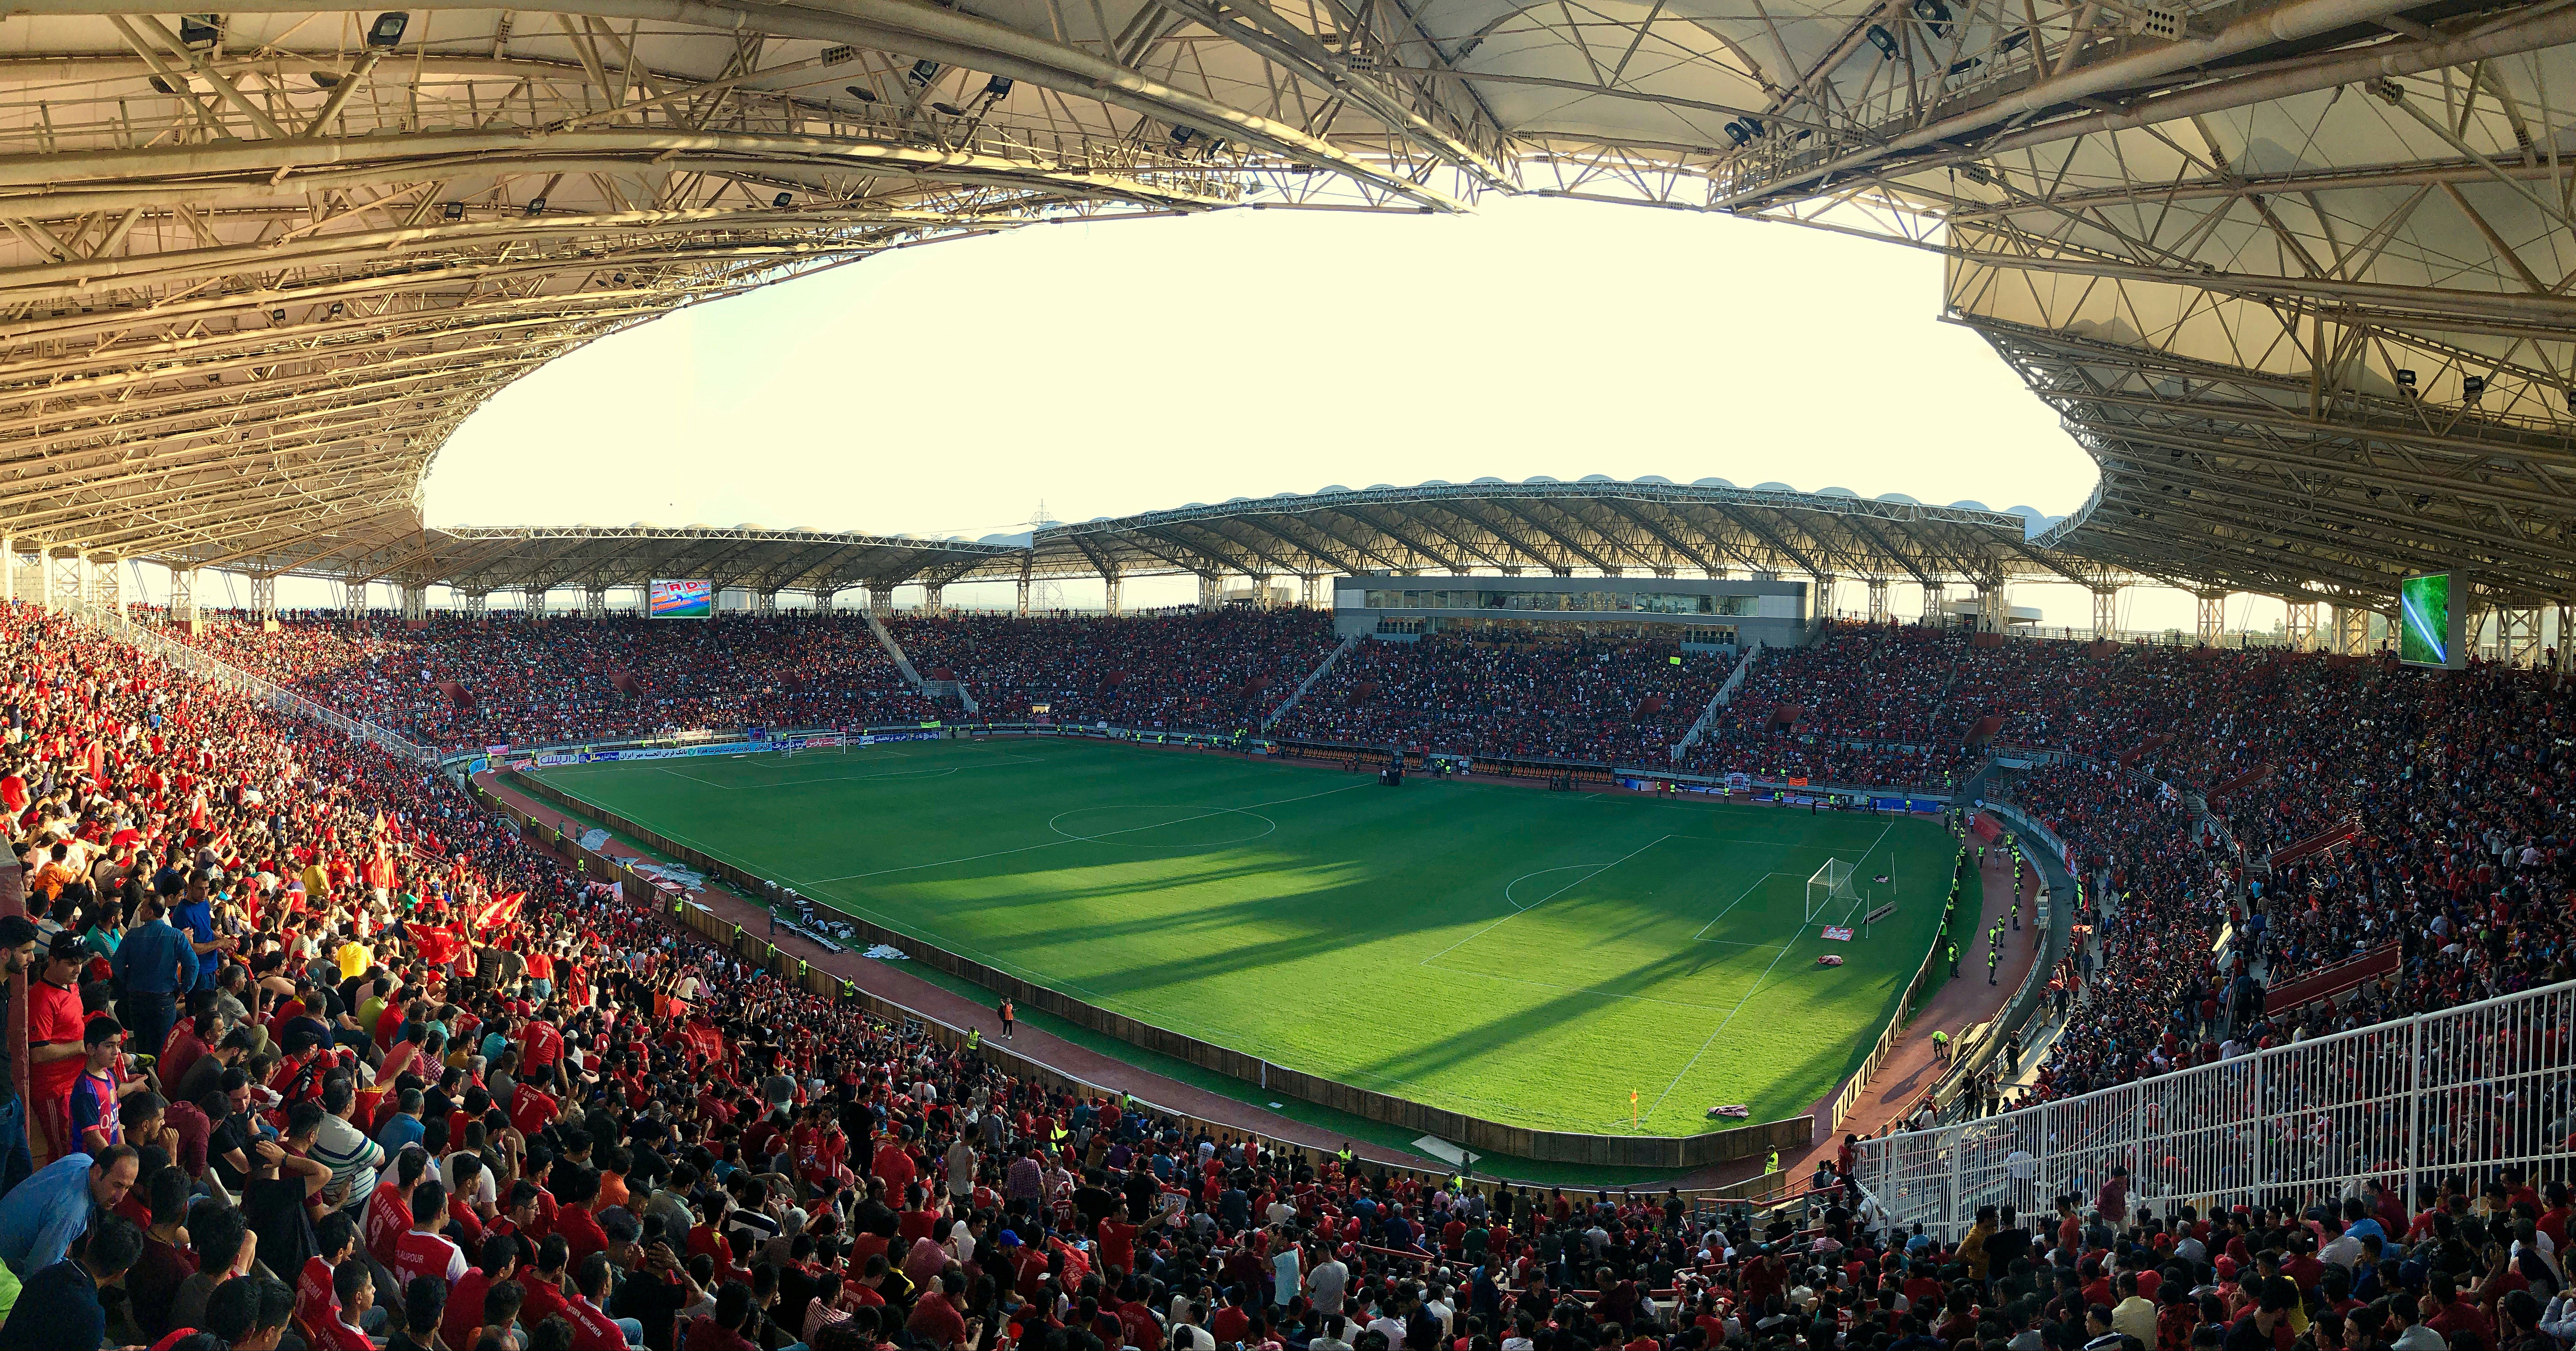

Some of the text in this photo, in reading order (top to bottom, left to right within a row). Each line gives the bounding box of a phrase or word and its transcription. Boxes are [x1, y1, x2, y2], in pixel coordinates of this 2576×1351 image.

[164, 1028, 180, 1053] 9
[538, 1031, 549, 1047] 7
[517, 1097, 528, 1116] 7
[1057, 1209, 1070, 1220] 70
[371, 1214, 383, 1248] 9
